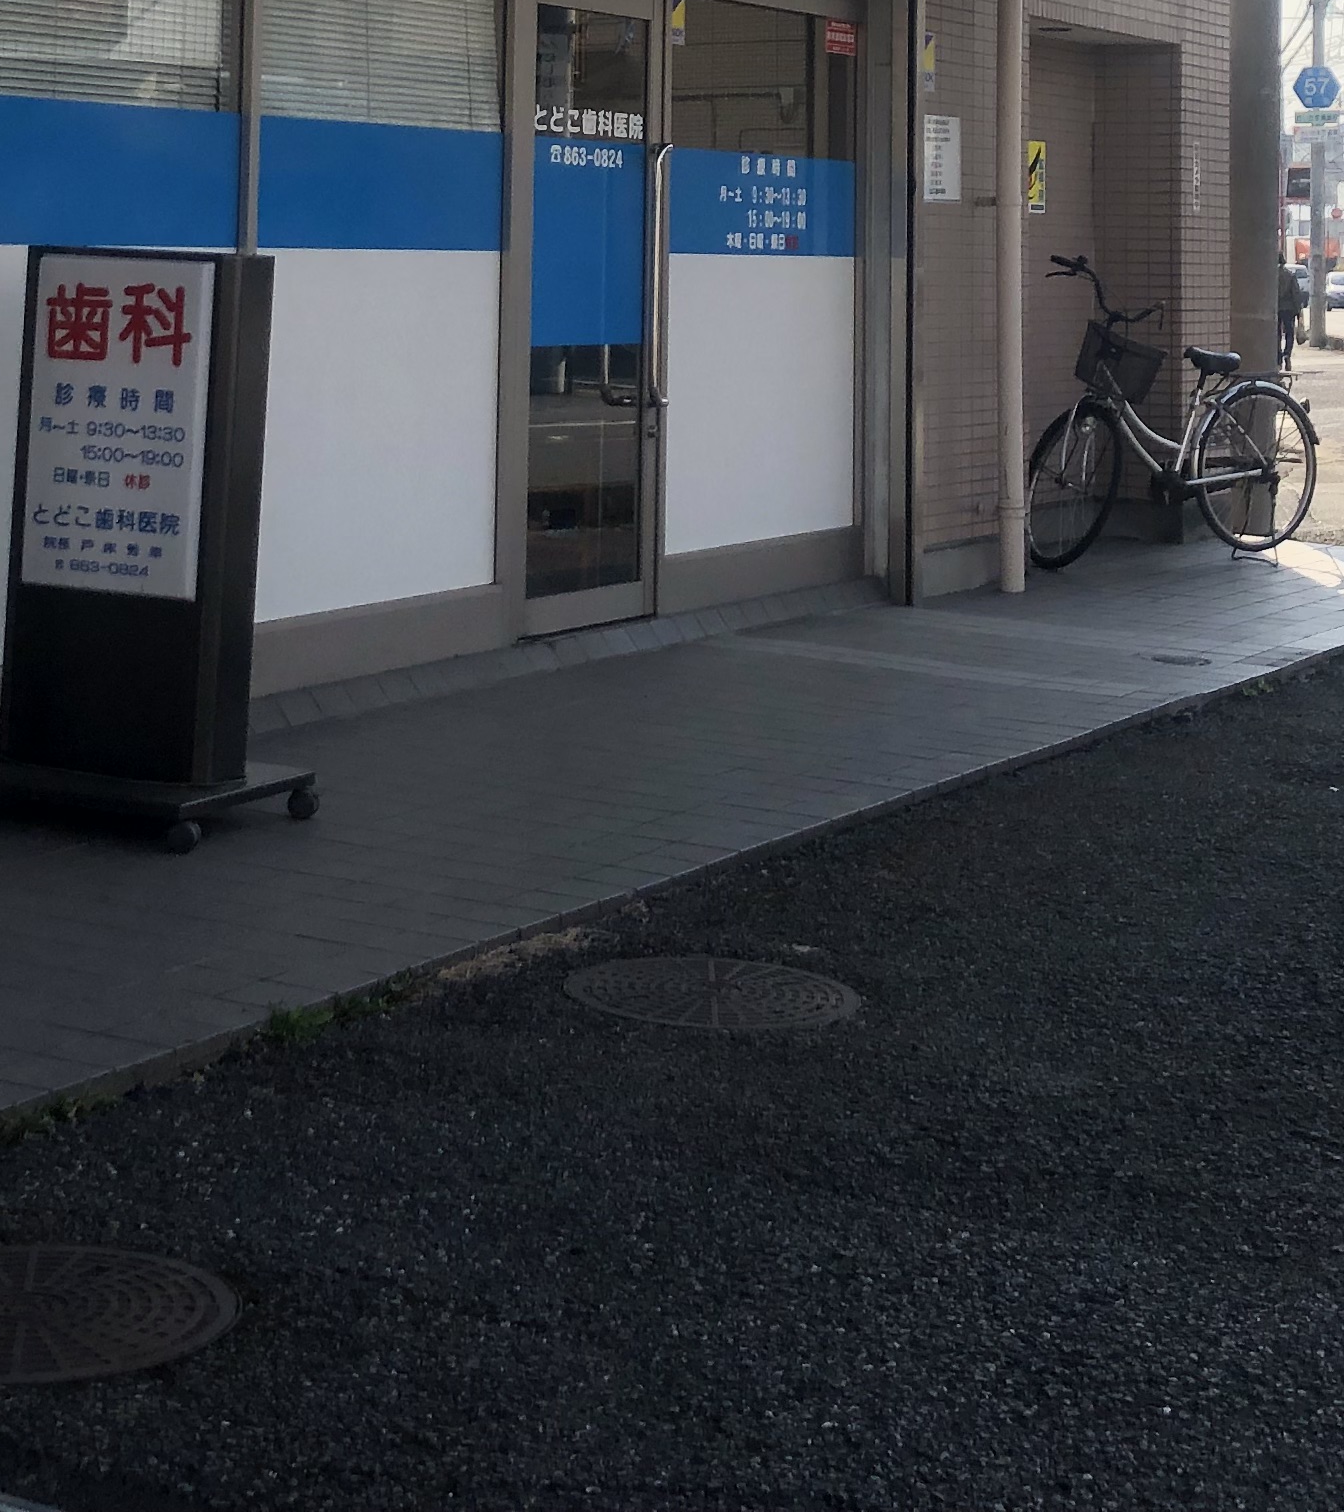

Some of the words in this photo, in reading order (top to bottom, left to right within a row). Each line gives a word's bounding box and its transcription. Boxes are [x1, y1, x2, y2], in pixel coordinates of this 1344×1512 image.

[1304, 78, 1329, 95] 57
[533, 104, 644, 139] とどこ歯科医院
[564, 145, 624, 168] 863-0824
[46, 283, 191, 366] 歯科
[55, 383, 175, 413] 診療時間
[33, 504, 180, 535] とどこ歯科医院
